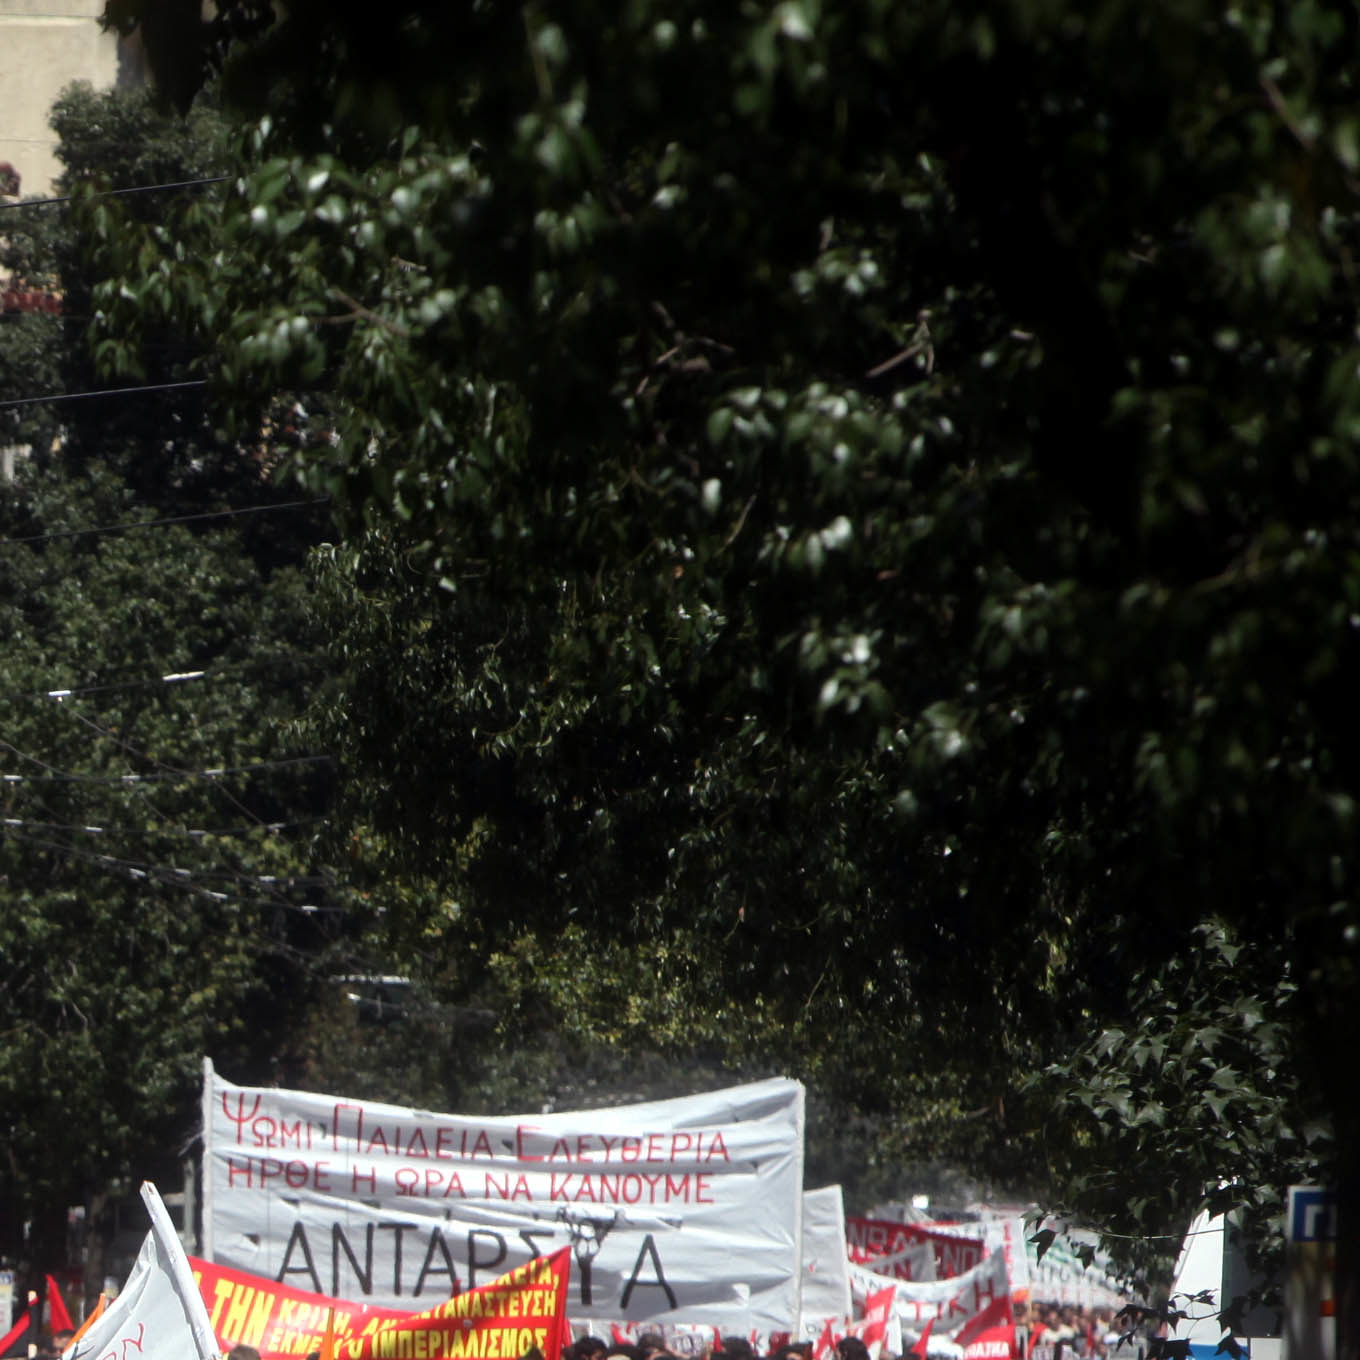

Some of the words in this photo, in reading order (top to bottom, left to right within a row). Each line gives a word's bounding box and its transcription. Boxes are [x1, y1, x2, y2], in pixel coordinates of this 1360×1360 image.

[222, 1091, 312, 1151] ΨΩΜΙ
[333, 1103, 494, 1161] ΠΑΙΔΕΙΑ
[228, 1157, 332, 1192] ΗΡΘΕ
[352, 1164, 377, 1194] Η
[394, 1168, 467, 1198] ΩΡΑ
[485, 1171, 532, 1202] ΝΑ
[550, 1172, 715, 1204] ΚΑΝΟΥΜΕ
[410, 1291, 558, 1321] ΑΝΑΣΤΕΥΣΗ
